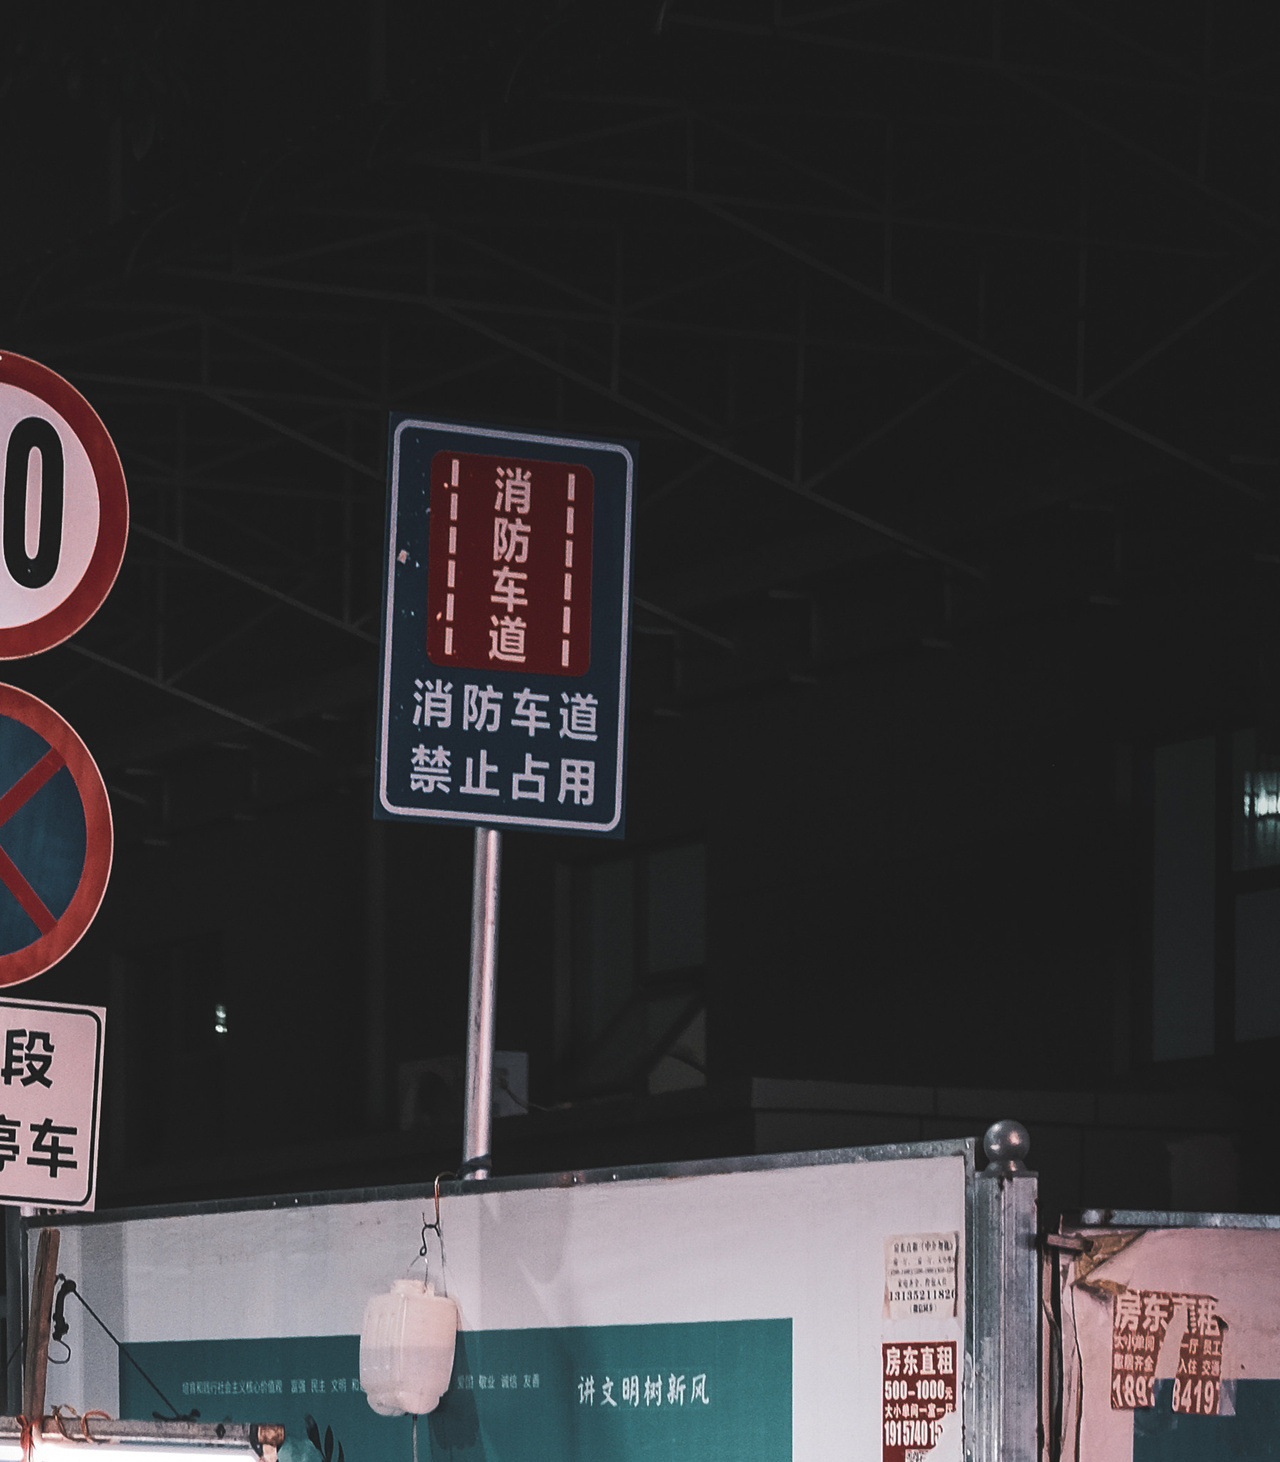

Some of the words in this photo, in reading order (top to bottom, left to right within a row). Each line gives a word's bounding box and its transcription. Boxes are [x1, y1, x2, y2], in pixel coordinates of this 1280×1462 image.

[488, 466, 532, 663] 消防车道
[412, 678, 598, 742] 消防车道
[410, 744, 596, 806] 禁止占用
[885, 1345, 953, 1376] 房东直租
[310, 1378, 326, 1394] 民主
[330, 1378, 347, 1393] 文明
[578, 1373, 710, 1407] 讲文明树新风
